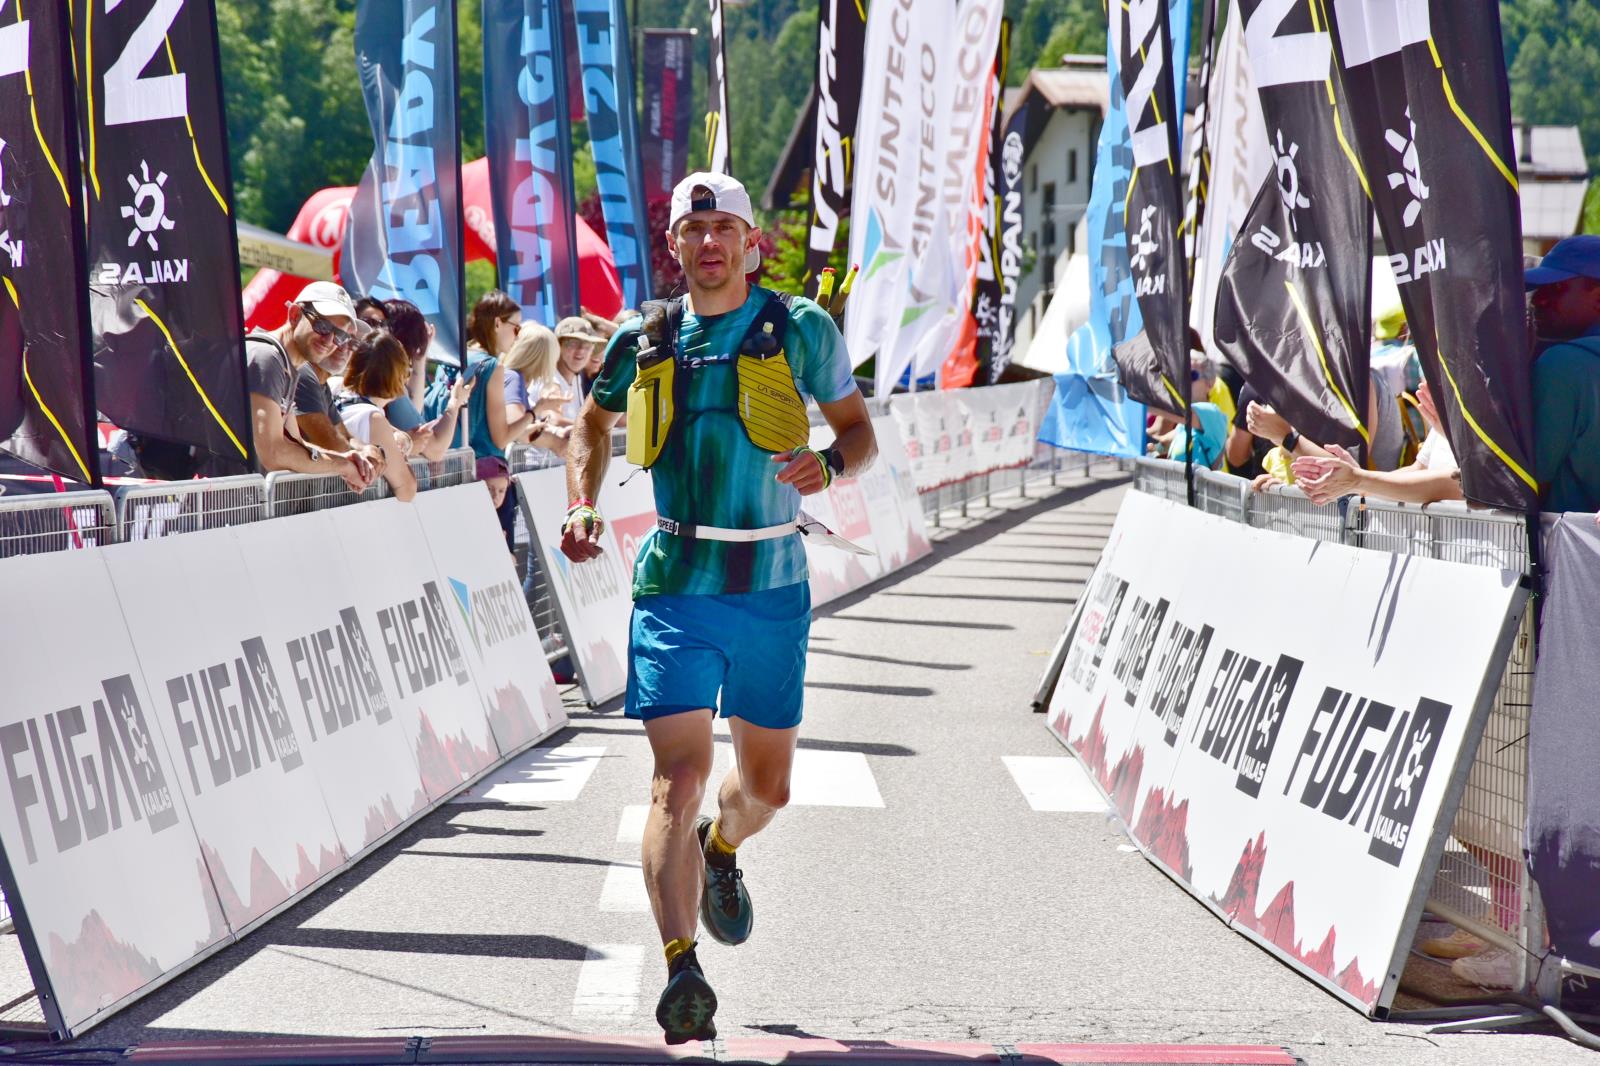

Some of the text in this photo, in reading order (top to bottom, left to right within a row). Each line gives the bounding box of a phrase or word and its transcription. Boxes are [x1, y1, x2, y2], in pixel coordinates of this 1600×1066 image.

[376, 596, 452, 700] FUGA
[471, 580, 527, 648] SINTECO
[286, 624, 371, 742] FUGA
[1147, 620, 1198, 726] FUGA
[1190, 648, 1272, 770] FUGA
[166, 657, 277, 796] FUGA
[1238, 755, 1267, 783] KAILAS
[1283, 685, 1411, 834] FUGA
[0, 699, 142, 865] FUGA
[141, 786, 173, 817] KAILAS
[1373, 814, 1409, 849] KAILAS
